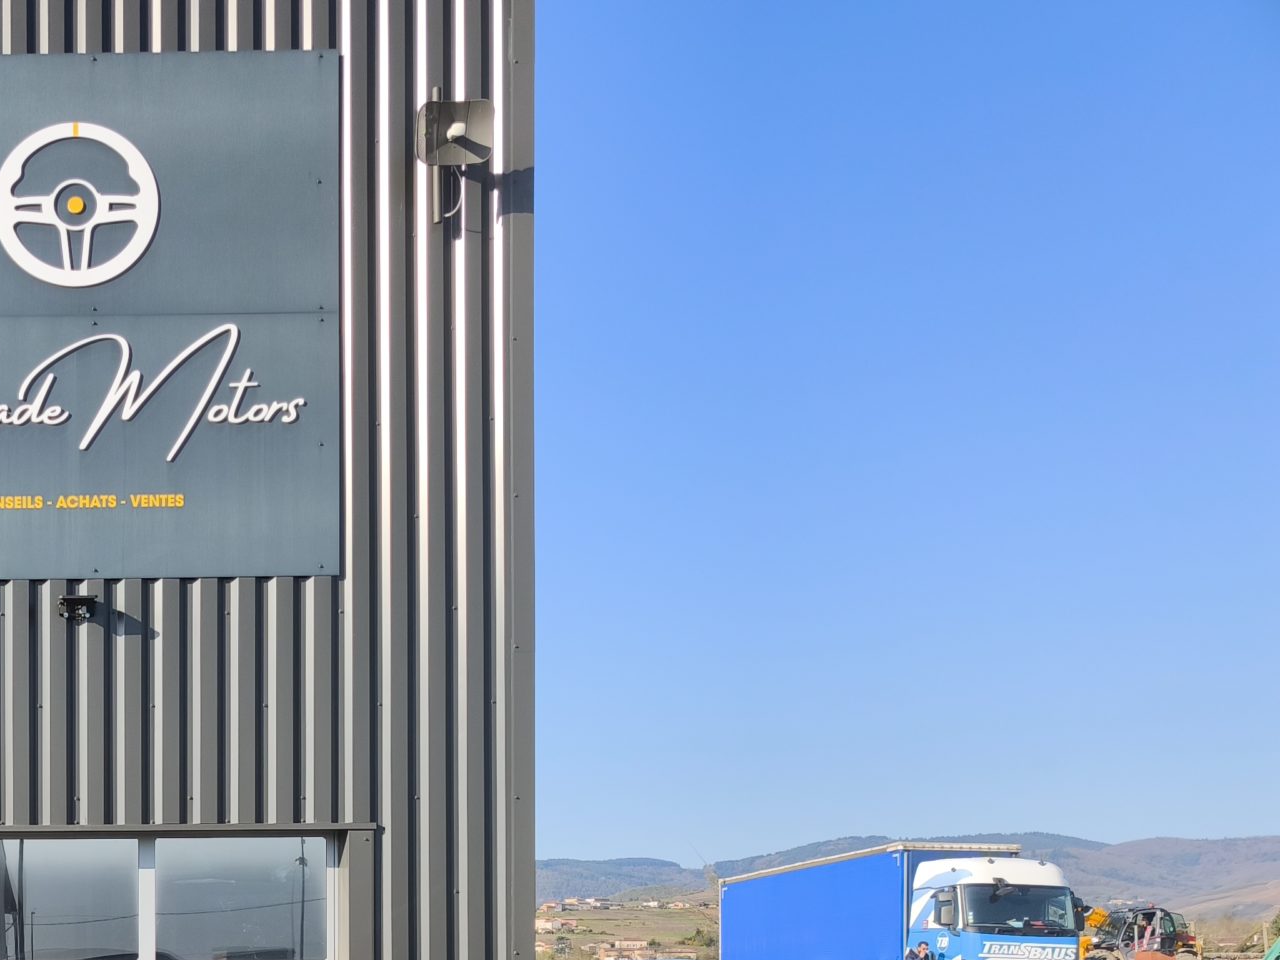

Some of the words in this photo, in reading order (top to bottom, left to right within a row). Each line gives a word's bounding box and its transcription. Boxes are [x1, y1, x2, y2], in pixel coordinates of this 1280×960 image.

[18, 323, 306, 463] Motors
[55, 494, 118, 509] ACHATS
[129, 493, 185, 508] VENTES
[978, 941, 1078, 960] TRANSBAUS
